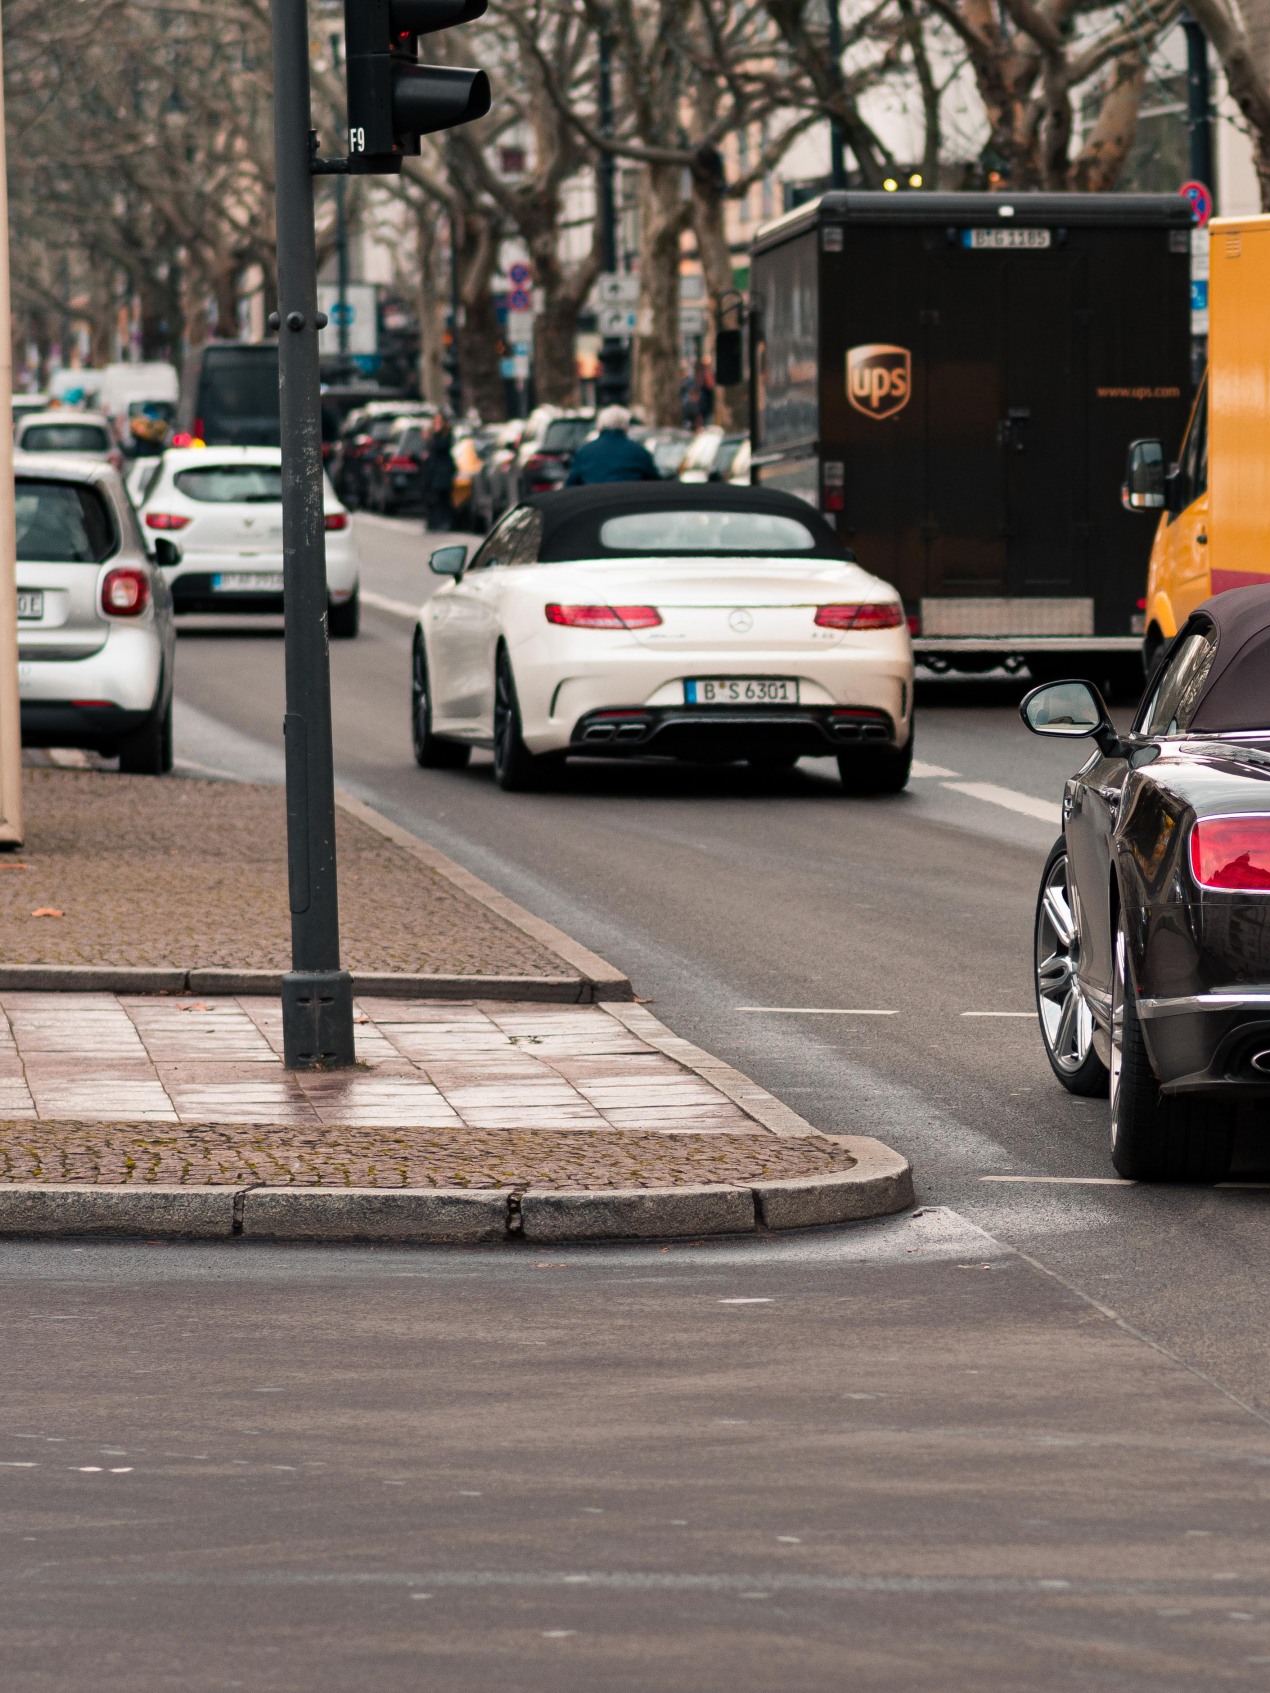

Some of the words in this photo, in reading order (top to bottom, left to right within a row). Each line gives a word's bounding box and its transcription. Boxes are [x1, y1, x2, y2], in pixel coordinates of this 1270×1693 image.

[350, 127, 365, 153] F9
[853, 367, 907, 408] ups
[1097, 386, 1181, 401] www.ups.com
[704, 683, 715, 700] B
[729, 683, 740, 699] S
[745, 683, 789, 699] 6301
